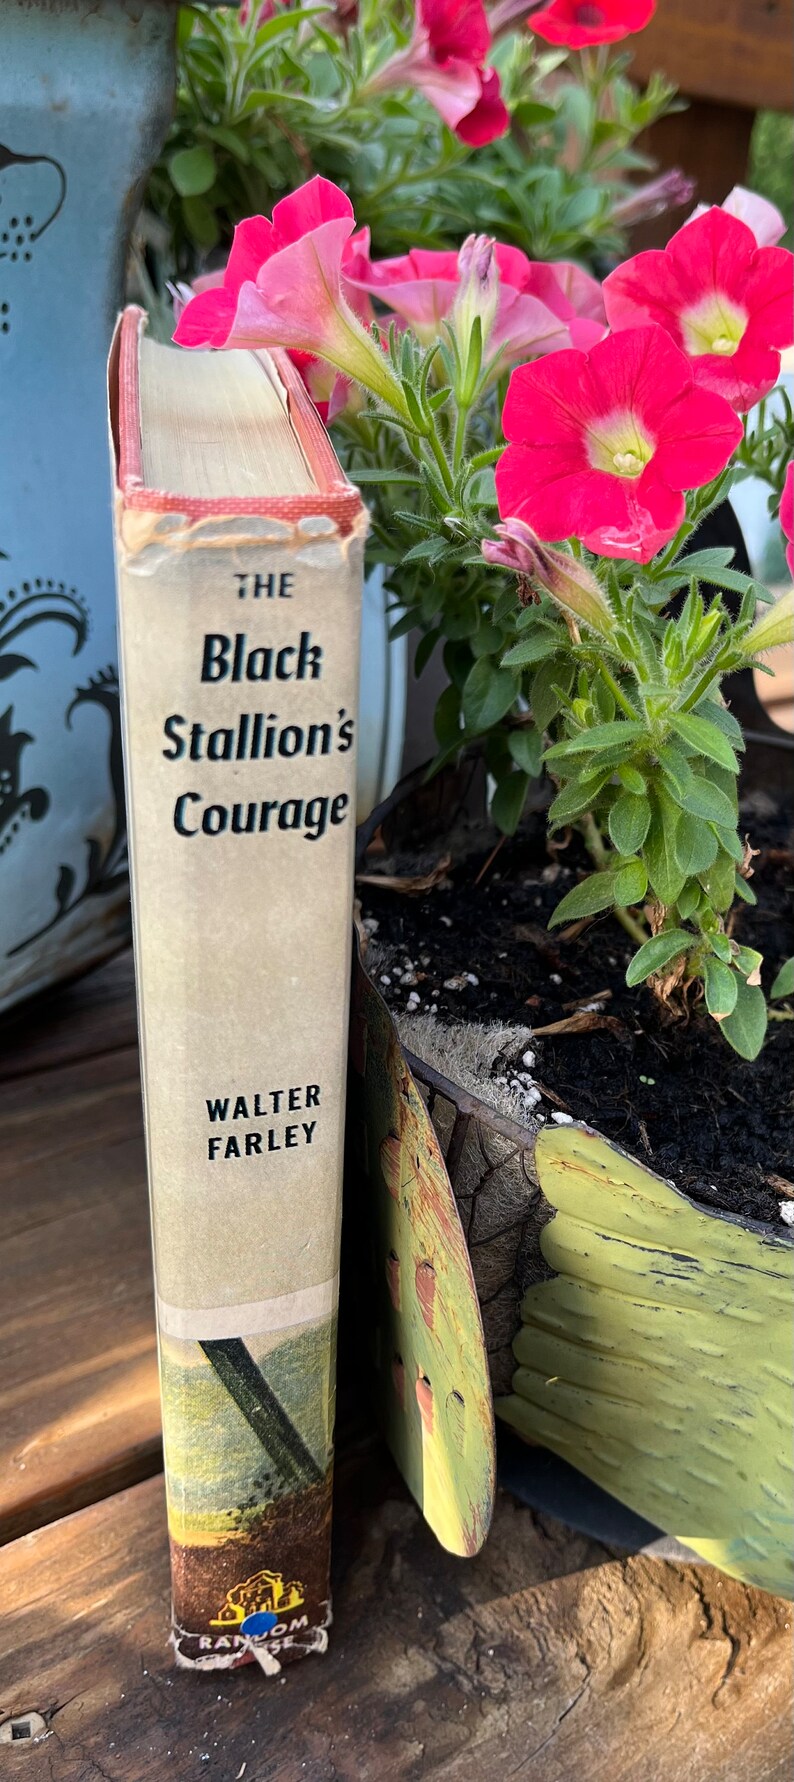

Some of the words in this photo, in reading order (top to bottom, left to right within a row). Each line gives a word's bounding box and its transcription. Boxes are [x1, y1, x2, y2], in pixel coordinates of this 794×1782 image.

[234, 573, 294, 598] THE
[200, 631, 322, 682] Black
[162, 708, 354, 761] Stallion's
[173, 791, 348, 841] Courage
[205, 1084, 321, 1122] WALTER
[208, 1120, 317, 1160] FARLEY
